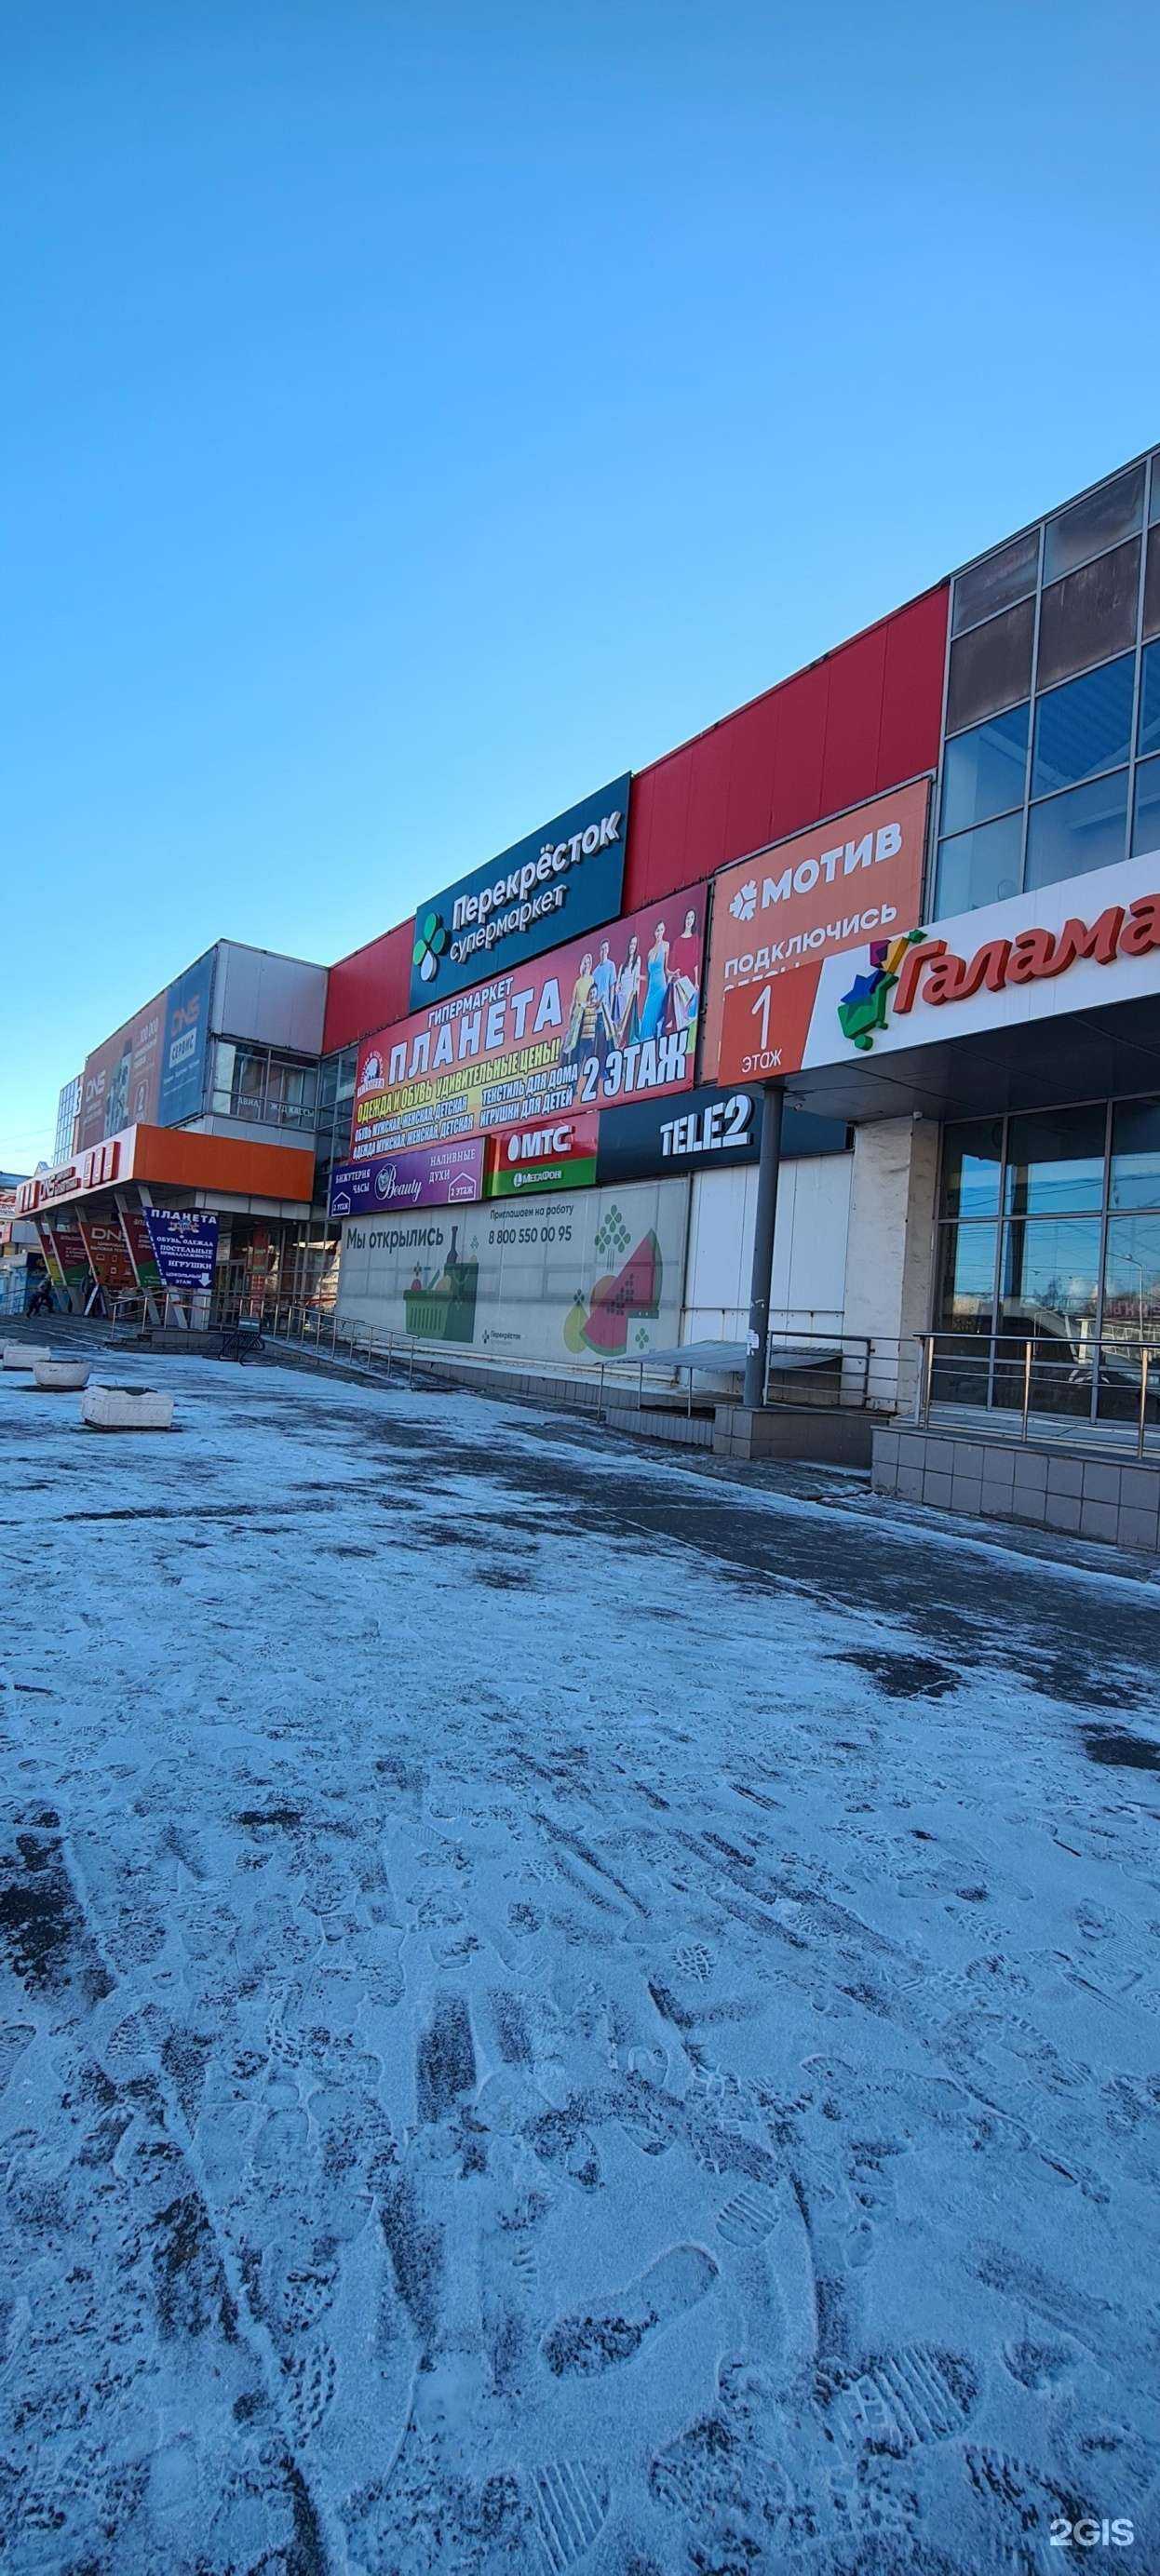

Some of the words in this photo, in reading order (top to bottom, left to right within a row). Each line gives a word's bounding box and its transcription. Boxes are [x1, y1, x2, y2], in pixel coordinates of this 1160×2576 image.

[452, 811, 621, 930] Перекрёсток
[761, 822, 902, 909] МОТИВ
[450, 884, 568, 963] супермаркет
[428, 977, 513, 1028] ГИПЕРМАРКЕТ
[751, 985, 771, 1050] 1
[388, 977, 562, 1086] ПЛАНЕТА
[580, 1056, 600, 1104] 2
[603, 1029, 688, 1098] ЭТАЖ
[742, 1048, 782, 1073] этаж
[357, 1093, 395, 1124] ОДЕЖДА
[393, 1089, 401, 1111] И
[401, 1079, 433, 1107] ОБУВЬ
[436, 1053, 519, 1099] УДИВИТЕЛЬНЫЕ
[482, 1080, 525, 1107] ТЕКСТИЛЬ
[526, 1074, 548, 1096] ДЛЯ
[548, 1063, 578, 1089] ДОМА
[435, 1095, 468, 1121] ДЕТСКАЯ
[479, 1104, 521, 1128] ИГРУШКИ
[521, 1096, 542, 1120] ДЛЯ
[543, 1087, 573, 1114] ДЕТЕЙ
[439, 1114, 474, 1140] ДЕТСКАЯ
[660, 1094, 752, 1156] TELE2
[521, 1124, 573, 1159] МТС
[430, 1149, 476, 1166] НАЛИВНЫЕ
[335, 1169, 371, 1184] БИЖУТЕРИЯ
[352, 1183, 370, 1194] ЧАСЫ
[374, 1163, 423, 1202] Beauty
[429, 1169, 450, 1184] ДУХИ
[451, 1187, 455, 1196] 2
[456, 1185, 473, 1196] ЭТАЖ
[151, 1209, 217, 1224] ПЛАНЕТА
[490, 1206, 533, 1220] Приглашаем
[546, 1204, 574, 1217] работу
[182, 1239, 213, 1247] ОДЕЖДА
[346, 1228, 365, 1249] Мы
[369, 1227, 444, 1254] открылись
[488, 1230, 494, 1244] 8
[496, 1228, 517, 1244] 800
[519, 1228, 538, 1243] 550
[540, 1227, 558, 1242] 00
[559, 1225, 573, 1241] 95
[160, 1244, 213, 1254] ПОСТЕЛЬНЫЕ
[168, 1260, 211, 1269] ИГРУШКИ
